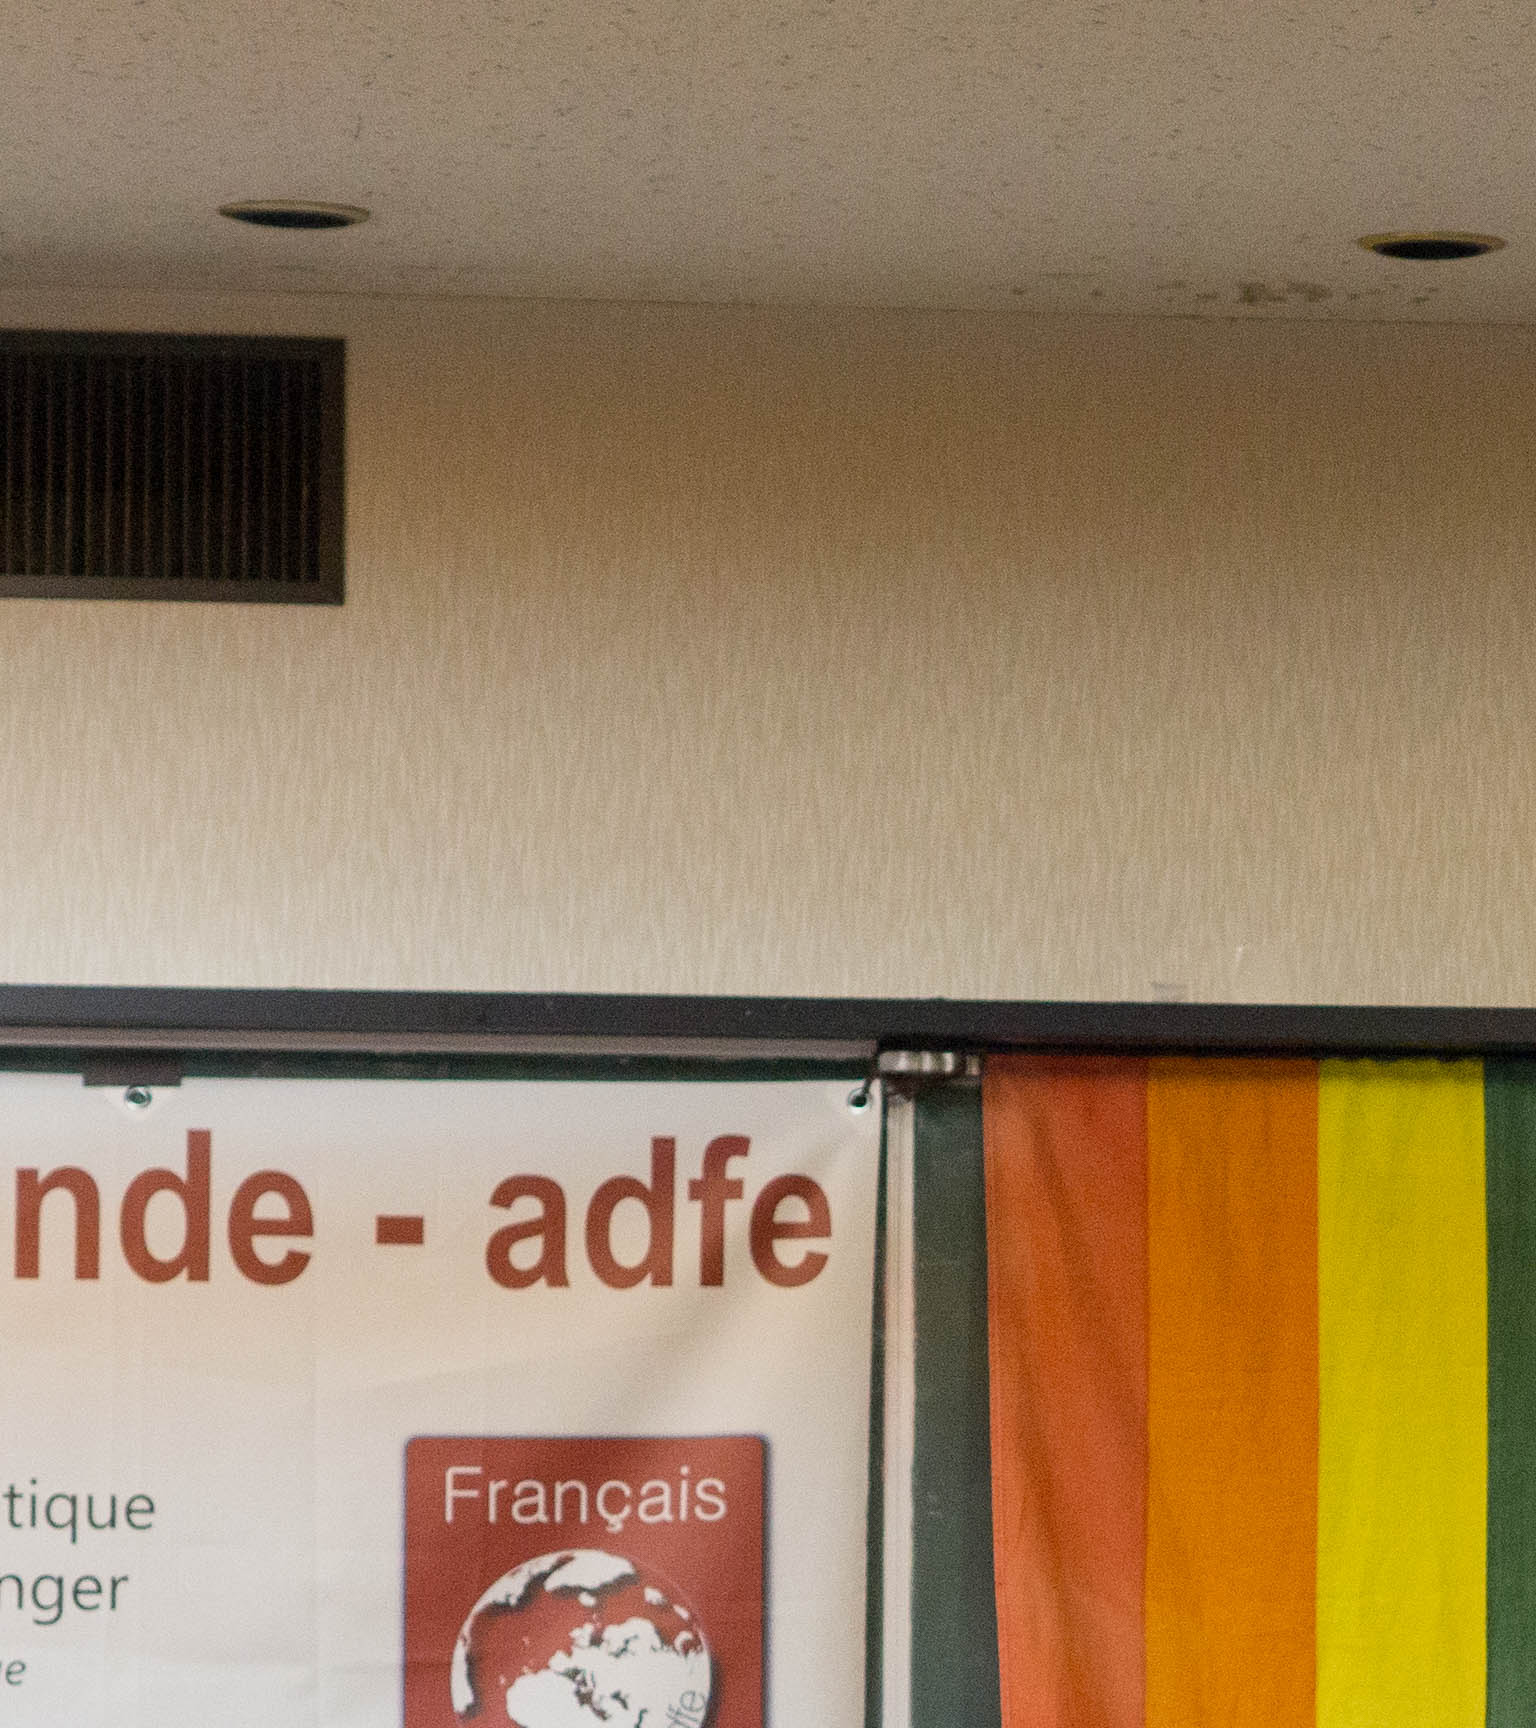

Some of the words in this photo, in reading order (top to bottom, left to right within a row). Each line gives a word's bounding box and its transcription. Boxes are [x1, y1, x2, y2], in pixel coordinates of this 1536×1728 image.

[13, 1128, 315, 1287] nde
[485, 1133, 834, 1290] adfe
[2, 1477, 156, 1544] tique
[443, 1465, 727, 1532] Français
